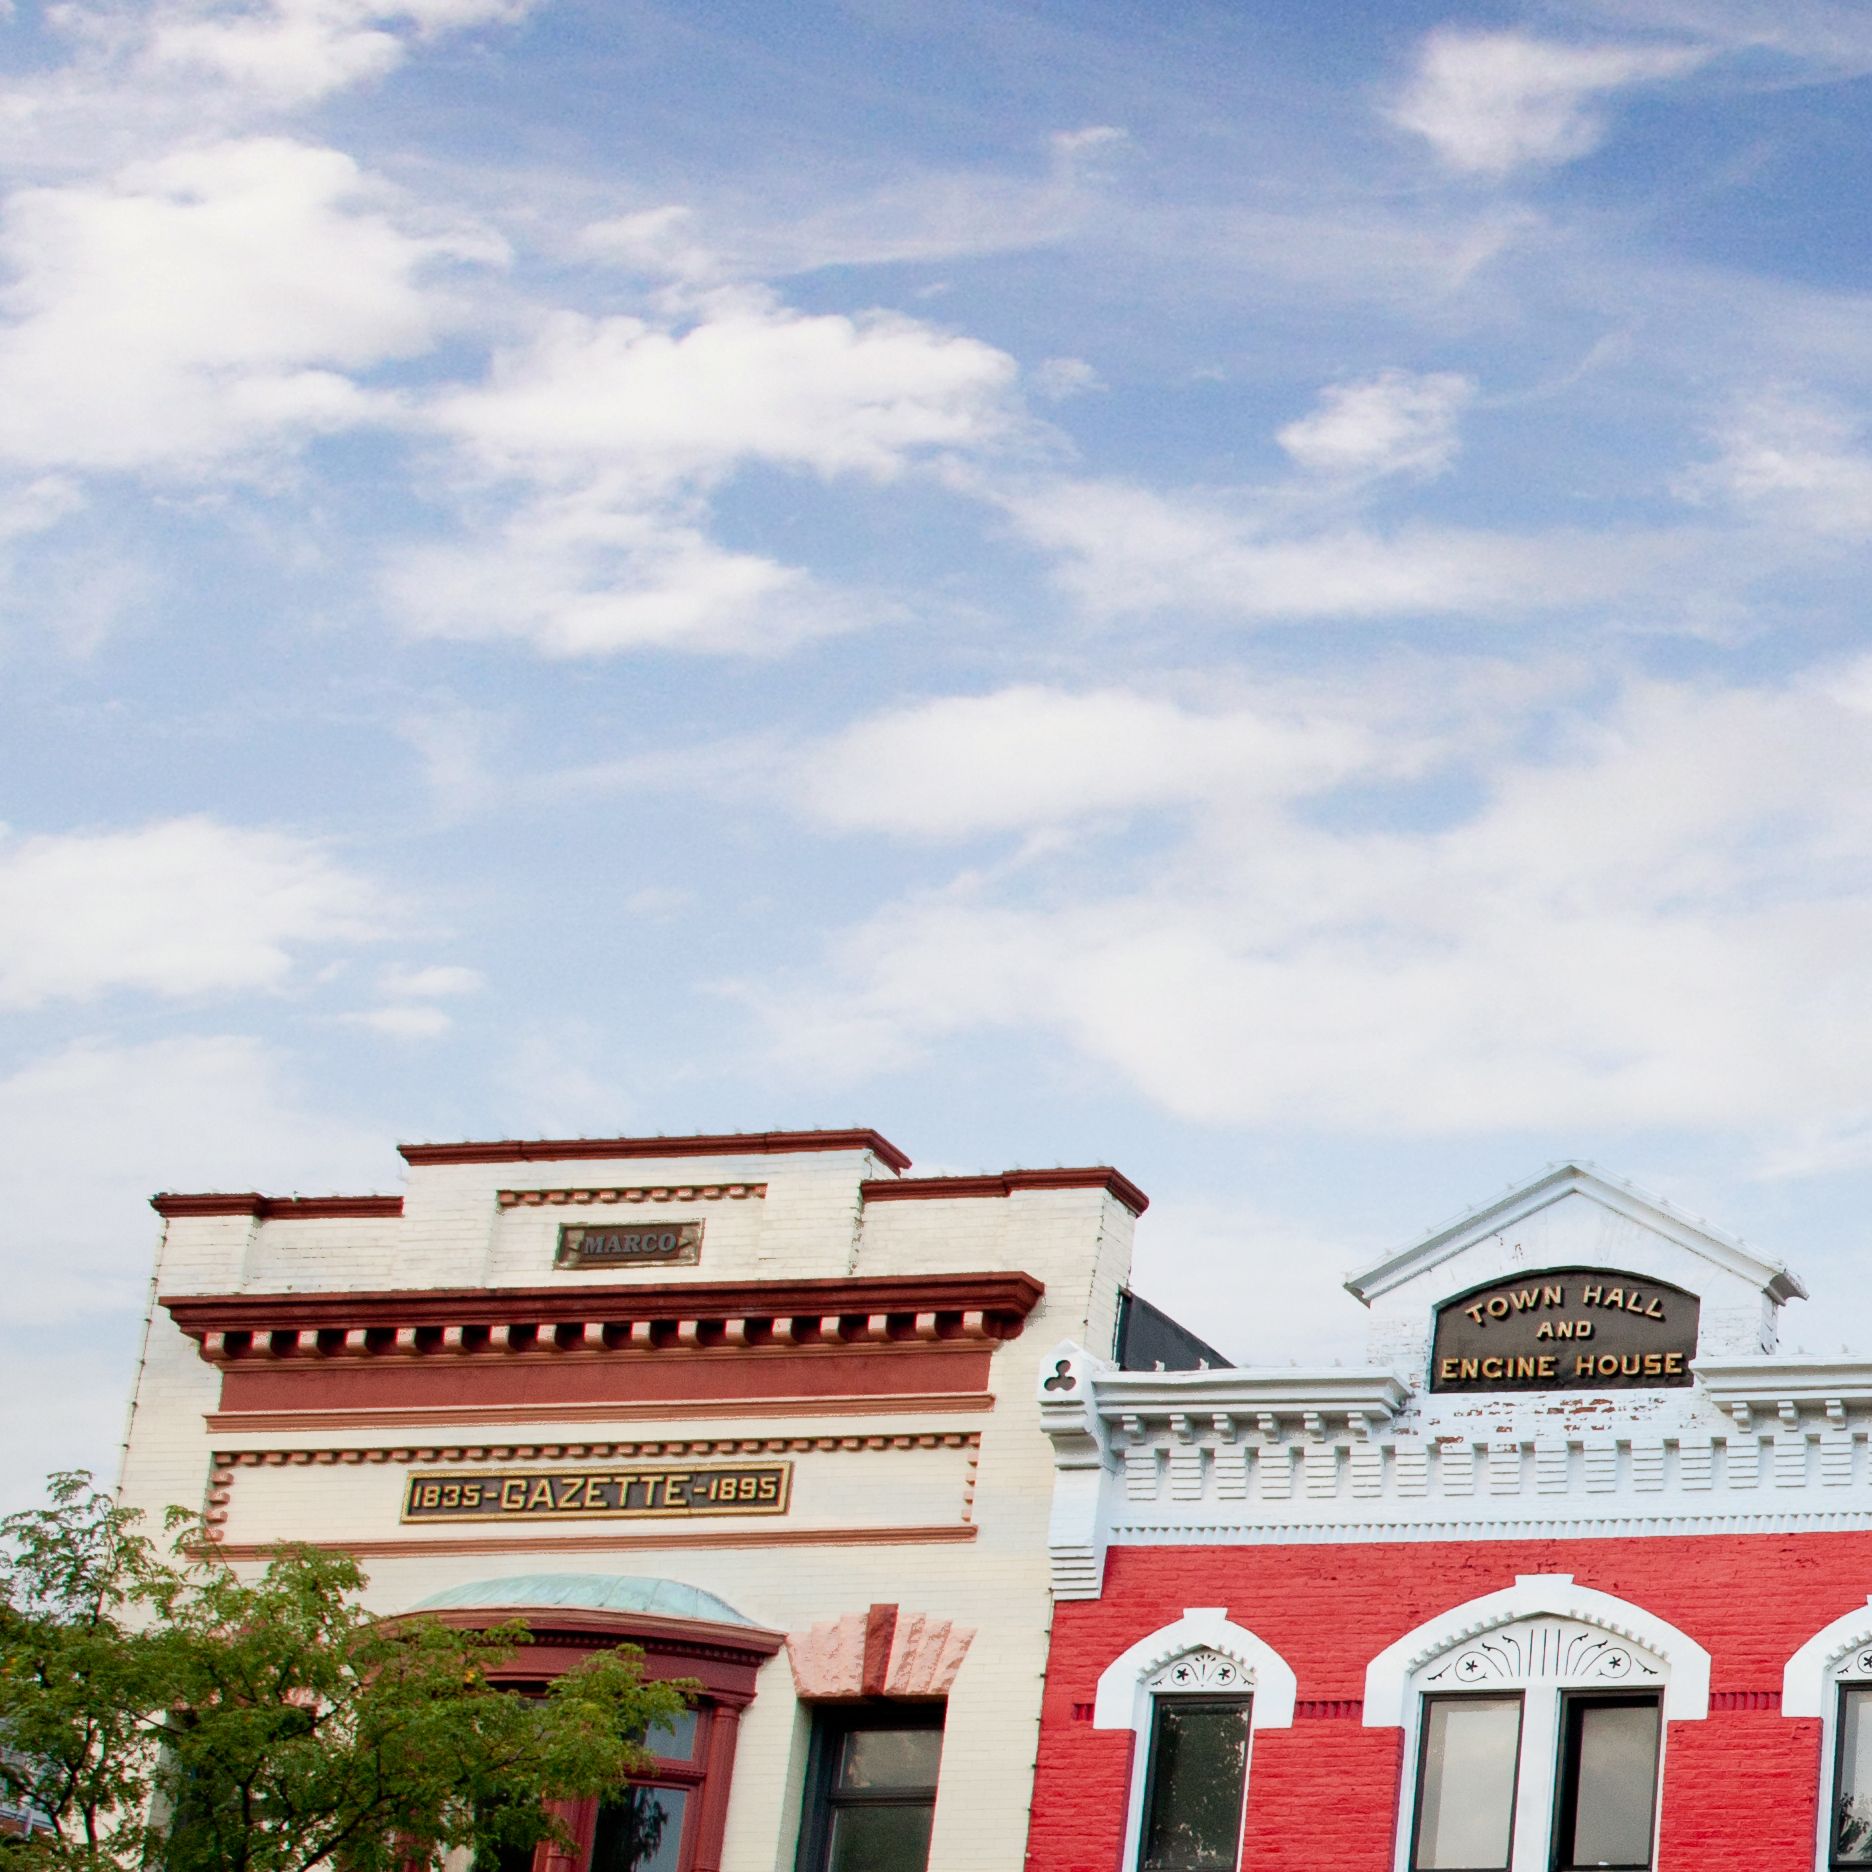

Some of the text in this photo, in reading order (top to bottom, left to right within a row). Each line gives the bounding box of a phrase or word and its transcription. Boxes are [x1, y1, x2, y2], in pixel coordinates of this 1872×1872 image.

[583, 1233, 677, 1255] MARCO
[1465, 1285, 1664, 1324] TOWN HALL
[1536, 1320, 1592, 1338] AND
[1441, 1352, 1683, 1378] ENGINE HOUSE
